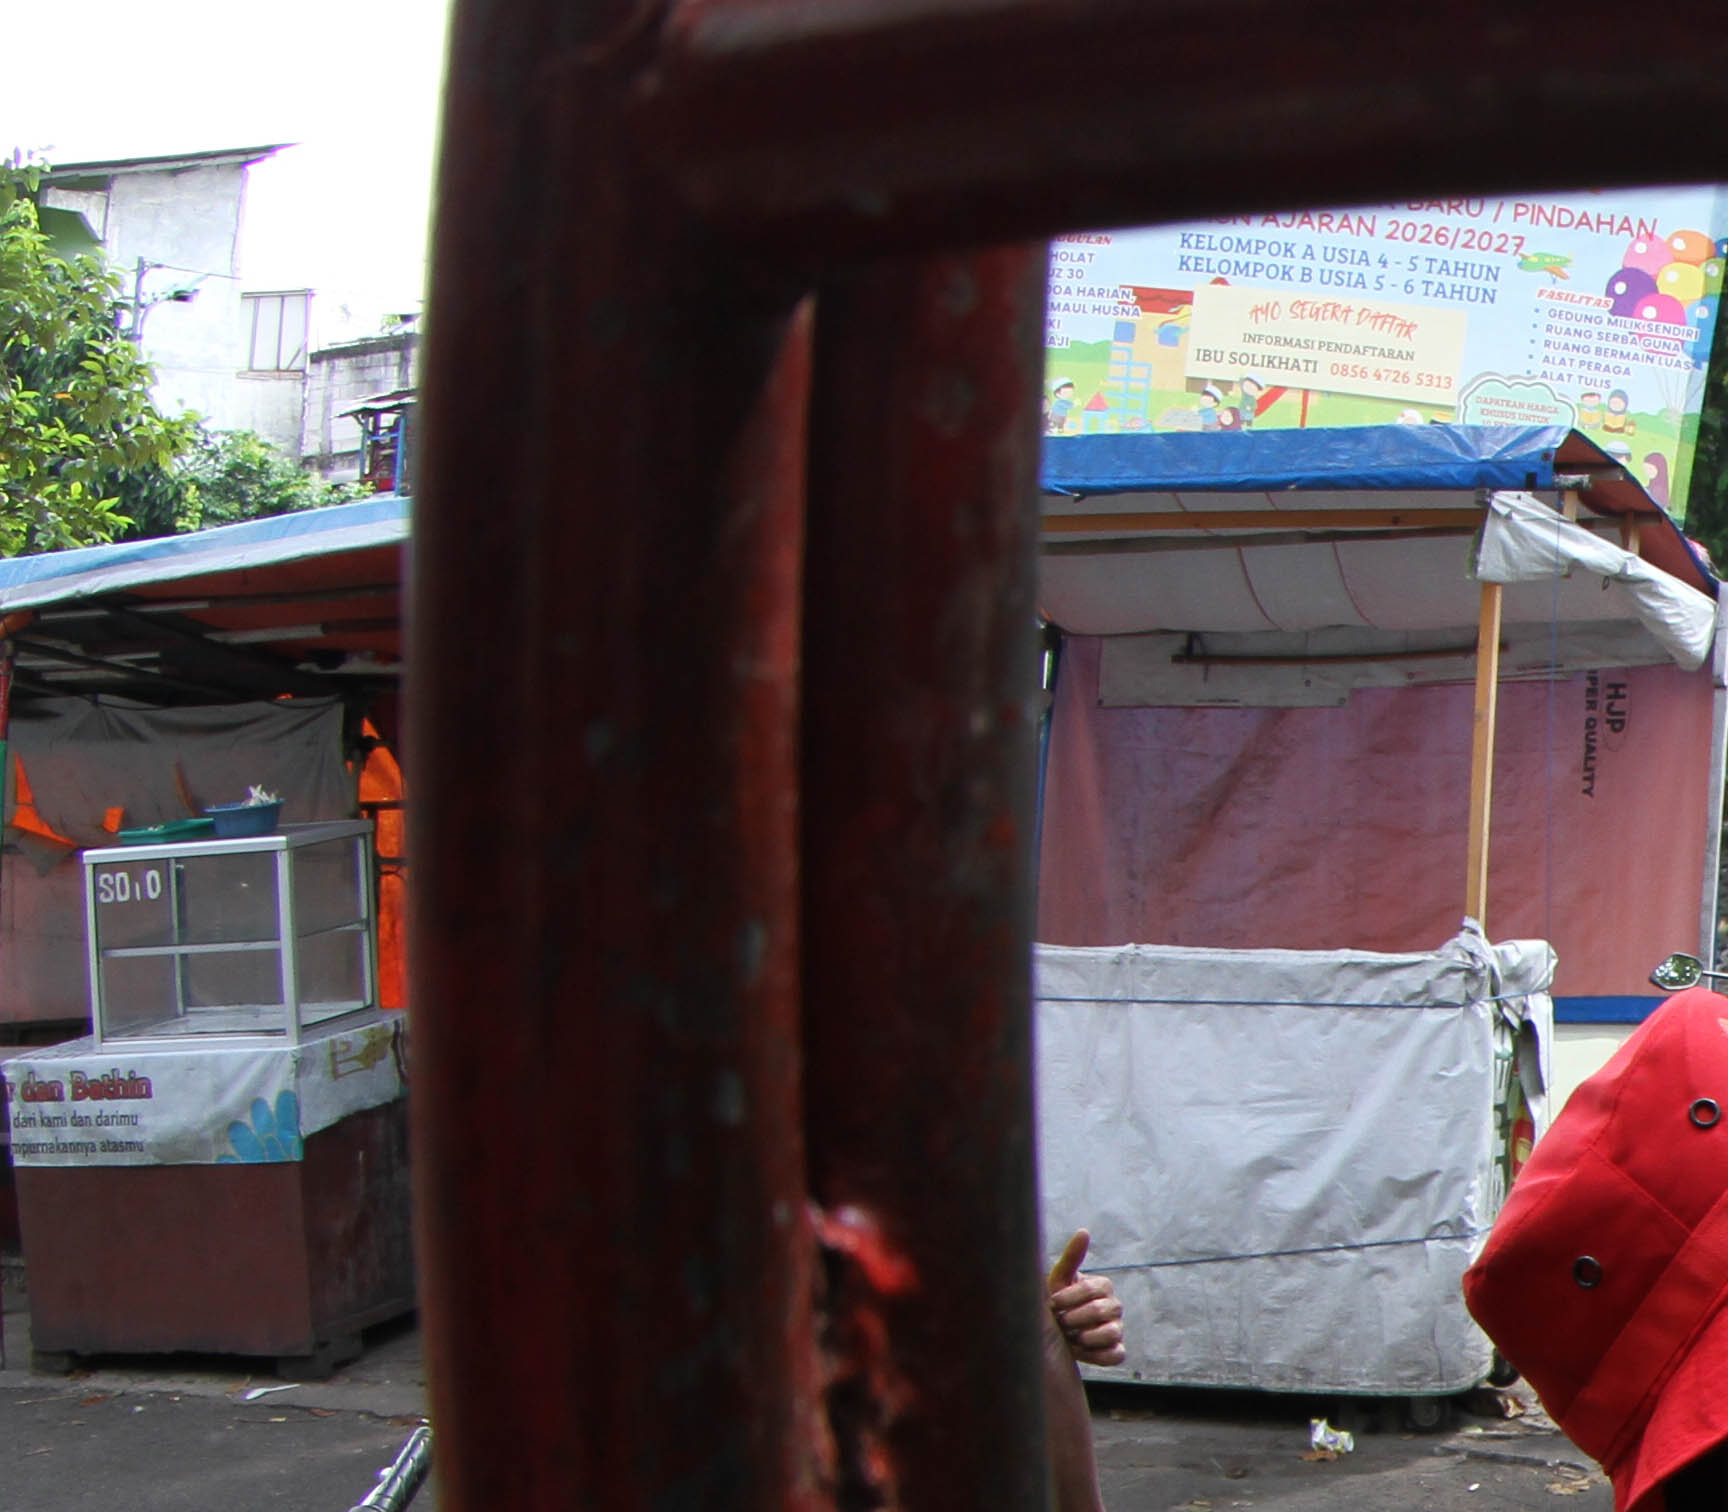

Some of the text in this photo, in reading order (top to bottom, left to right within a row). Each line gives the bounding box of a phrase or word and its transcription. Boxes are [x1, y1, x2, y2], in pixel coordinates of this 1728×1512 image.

[1261, 211, 1377, 238] AJARAN
[1385, 220, 1526, 256] 2026/2027
[1513, 202, 1658, 240] PINDAHAN
[1179, 232, 1298, 260] KELOMPOK
[1301, 244, 1316, 261] A
[1322, 246, 1372, 267] USIA
[1377, 253, 1389, 269] 4
[1407, 256, 1419, 272] 5
[1425, 257, 1501, 282] TAHUN
[1067, 268, 1084, 279] 30
[1177, 255, 1295, 282] KELOMPOK
[1300, 267, 1313, 283] B
[1319, 268, 1368, 289] USIA
[1373, 275, 1385, 291] 5
[1403, 279, 1415, 295] 6
[1421, 280, 1498, 304] TAHUN
[1092, 305, 1141, 317] HUSNA
[1536, 288, 1613, 309] FASILITAS
[1249, 299, 1418, 341] AYO SEGERA DAFTAR
[1548, 308, 1699, 340] GEDUNG MILIK SENDIRI
[1242, 332, 1415, 361] INFORMASI PENDAFTARAN
[1545, 324, 1681, 352] RUANG SERBA GUNA
[1195, 349, 1453, 390] IBU SOLIKHATI 0856 4726 5313
[1542, 355, 1632, 376] ALAT PERAGA
[1543, 339, 1694, 371] RUANG BERMAIN LUAS
[1539, 370, 1612, 389] ALAT TULIS
[1605, 682, 1628, 733] HJP
[1582, 716, 1598, 798] QUALITY
[21, 1071, 65, 1102] dan
[70, 1067, 153, 1101] Bathin
[13, 1109, 139, 1129] dari kami dan darimu
